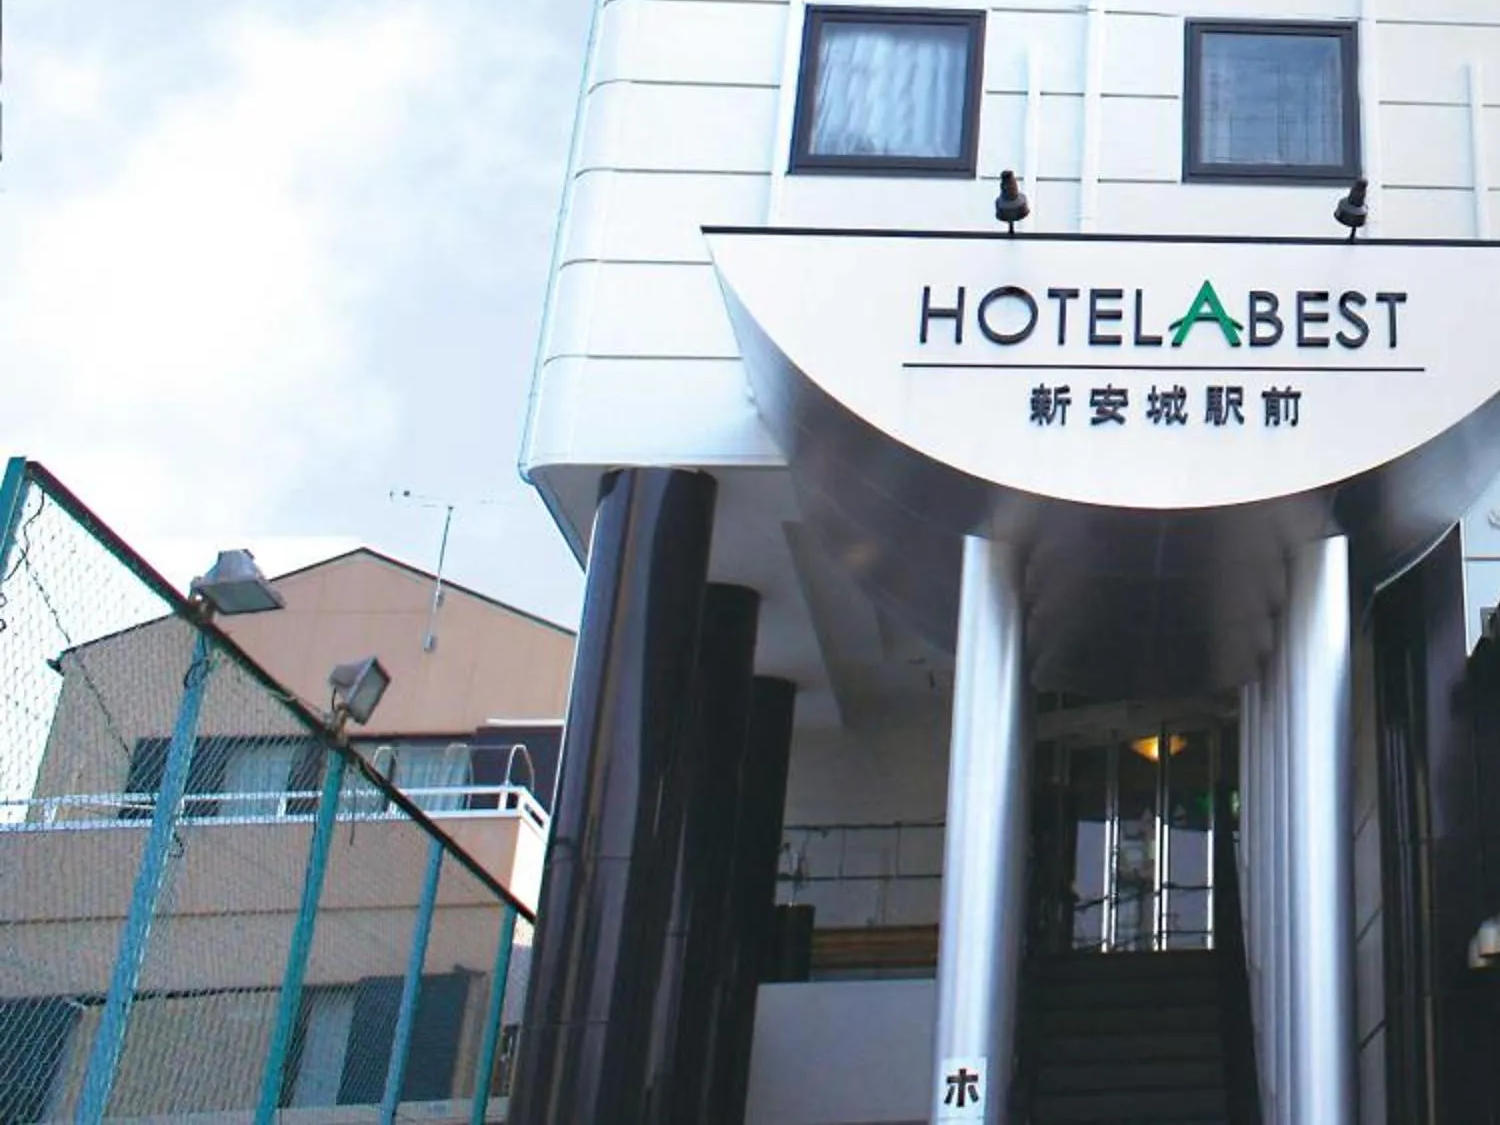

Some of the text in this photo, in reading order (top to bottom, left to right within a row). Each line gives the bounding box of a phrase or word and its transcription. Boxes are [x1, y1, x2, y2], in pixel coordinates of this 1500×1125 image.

[1030, 384, 1302, 427] 新安城駅前
[944, 1068, 979, 1107] ホ
